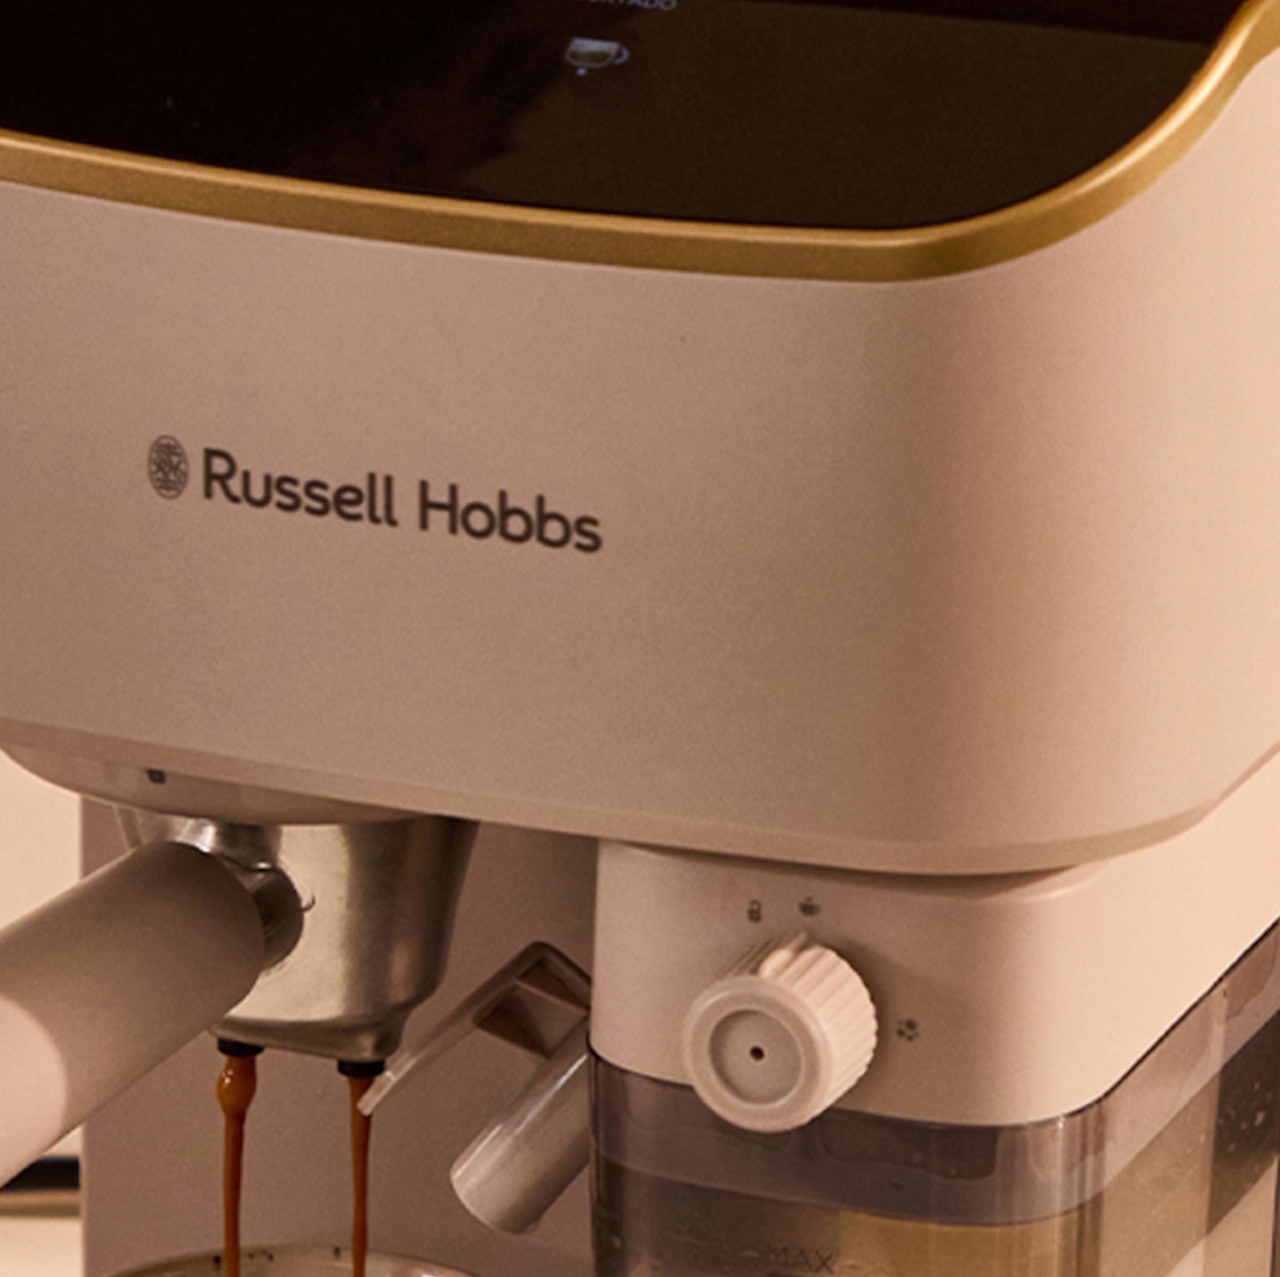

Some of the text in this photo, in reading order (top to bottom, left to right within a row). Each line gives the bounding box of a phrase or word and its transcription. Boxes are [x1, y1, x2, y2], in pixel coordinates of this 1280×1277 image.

[202, 446, 604, 554] Russell Hobbs
[766, 1244, 835, 1275] MAX
